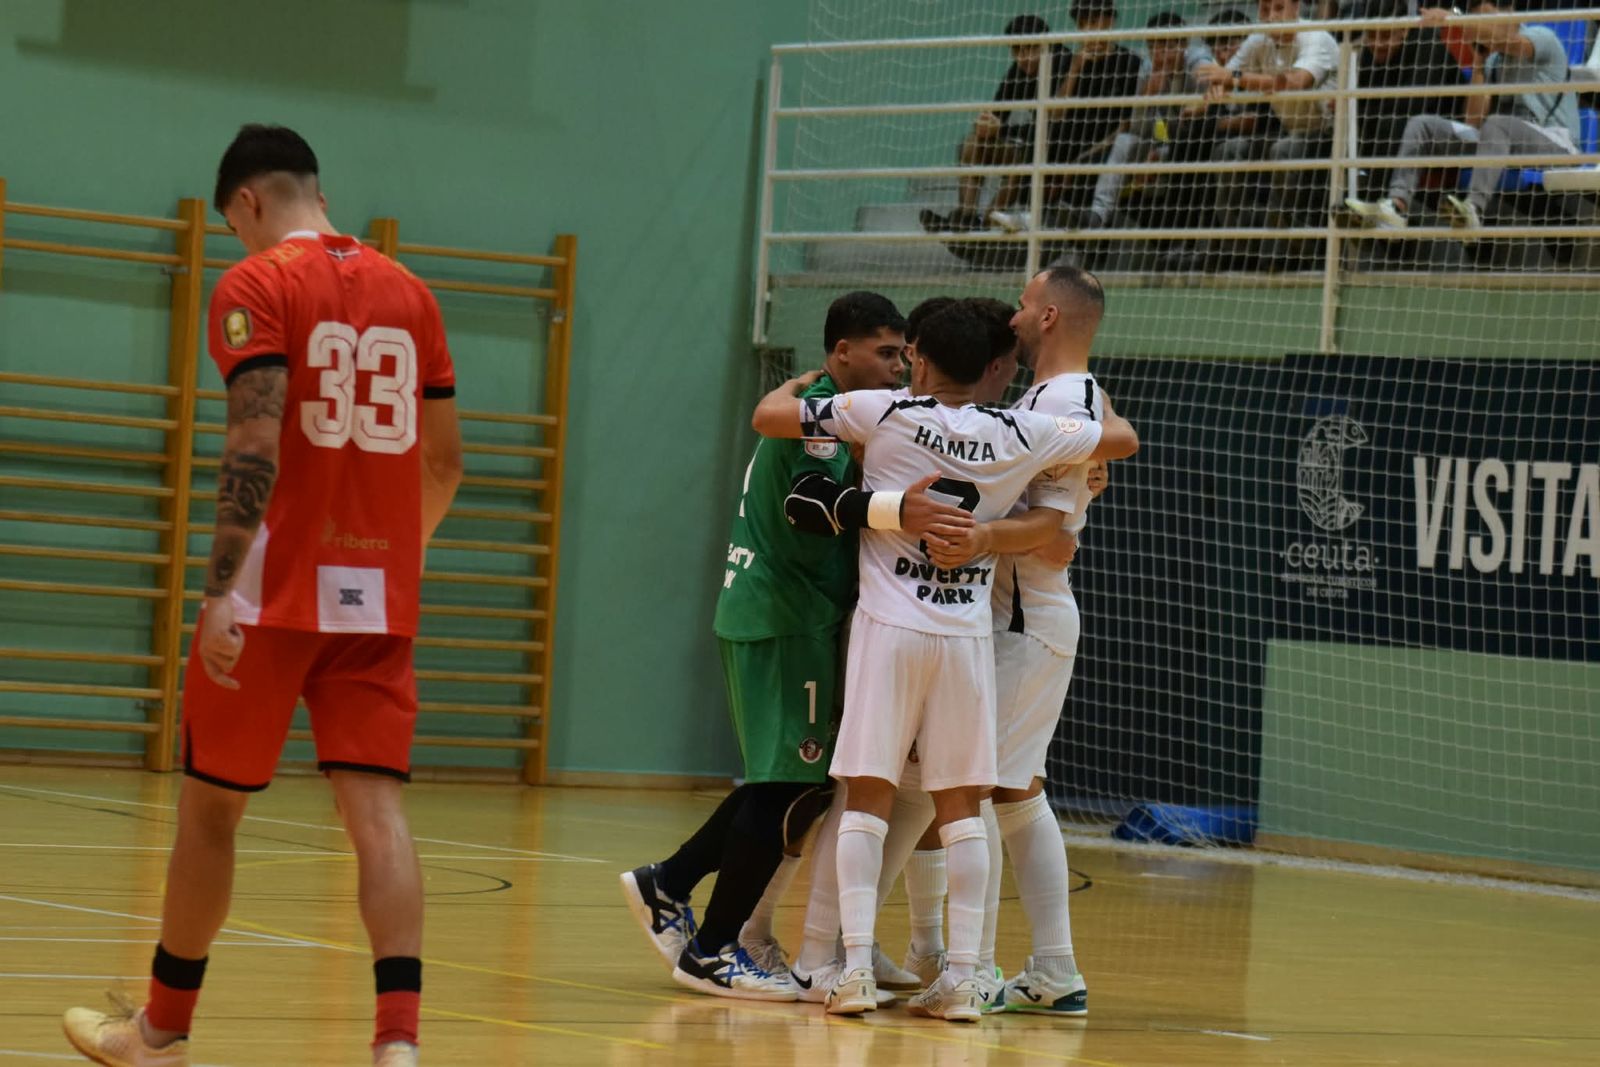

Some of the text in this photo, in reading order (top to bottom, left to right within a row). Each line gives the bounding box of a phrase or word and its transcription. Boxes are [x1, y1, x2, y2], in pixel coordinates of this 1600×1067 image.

[300, 321, 418, 455] 33
[914, 425, 996, 462] HAMZA
[1413, 456, 1600, 578] VISITA
[916, 585, 975, 605] PARK
[804, 681, 816, 723] 1
